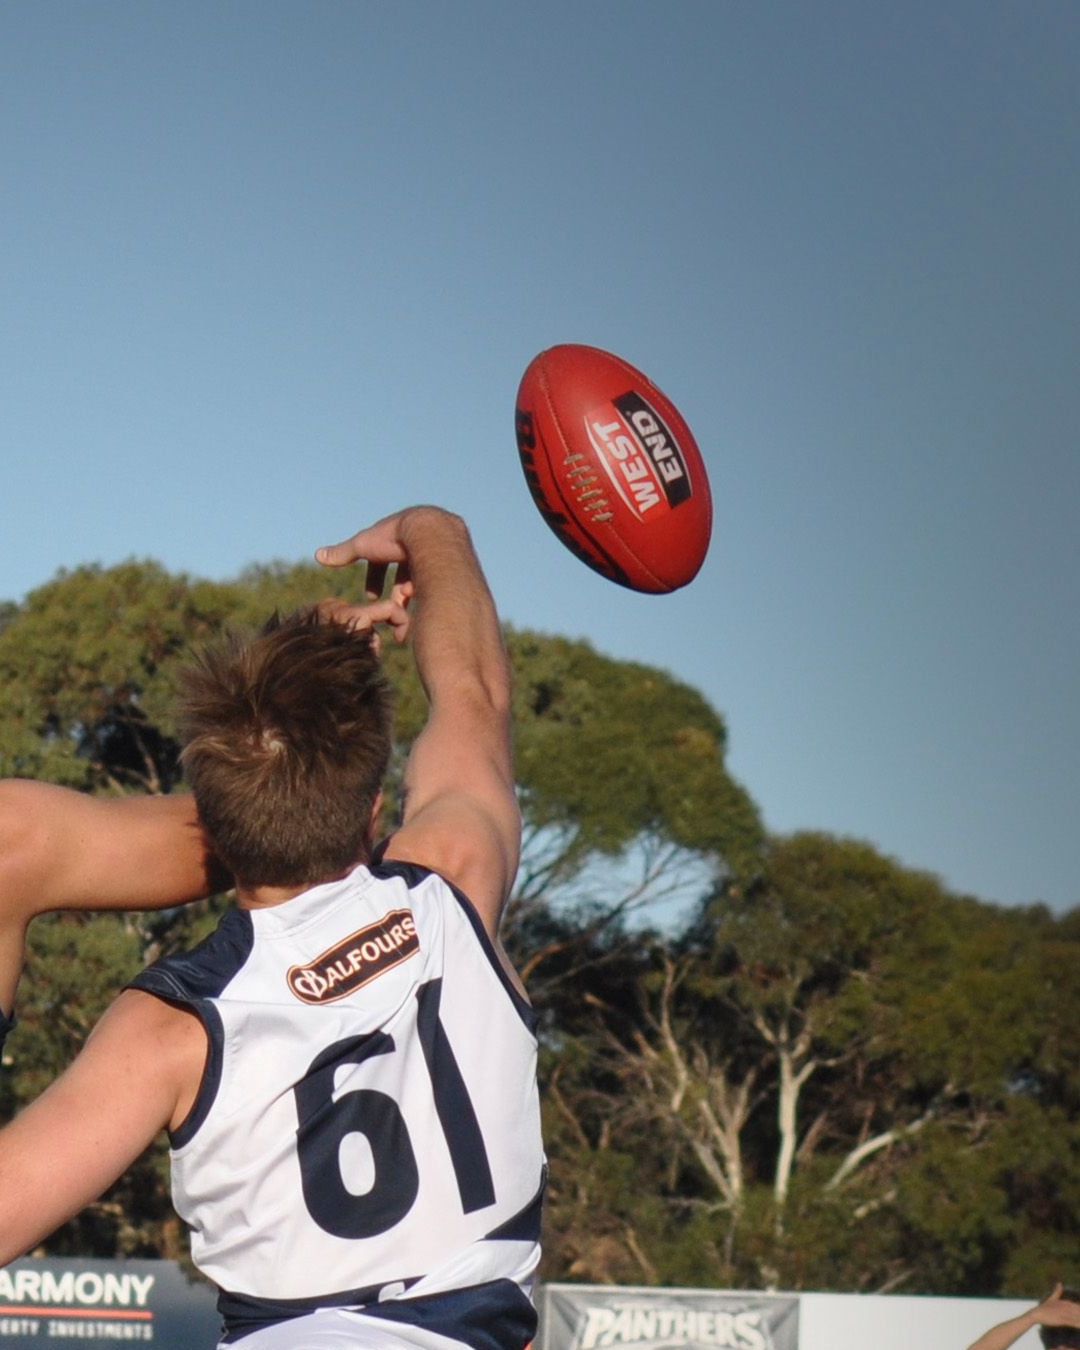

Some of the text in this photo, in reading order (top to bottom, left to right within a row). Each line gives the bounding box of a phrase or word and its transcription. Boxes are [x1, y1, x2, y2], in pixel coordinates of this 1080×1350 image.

[593, 420, 661, 514] WEST
[630, 410, 684, 484] END
[294, 916, 417, 999] BALFOURS
[293, 976, 497, 1240] 61
[48, 1320, 154, 1341] INVESTMENTS
